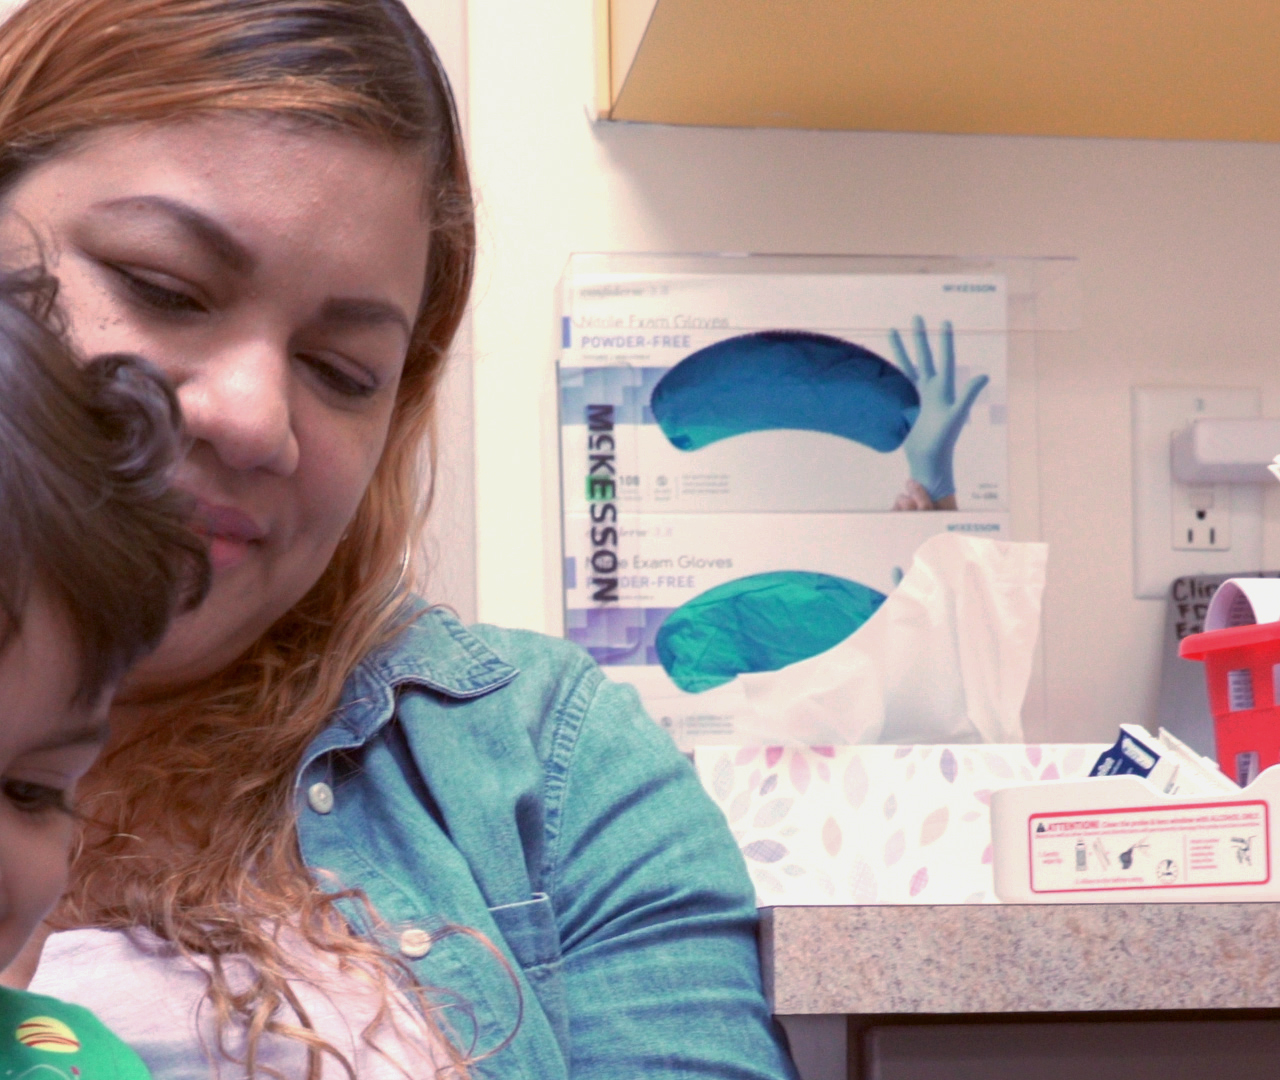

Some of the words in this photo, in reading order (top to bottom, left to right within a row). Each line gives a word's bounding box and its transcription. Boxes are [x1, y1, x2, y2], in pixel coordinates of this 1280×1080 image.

[628, 315, 670, 328] Exam
[673, 314, 729, 328] Gloves
[581, 335, 691, 348] POWDER-FREE
[633, 555, 674, 569] Exam
[677, 555, 733, 569] Gloves
[586, 575, 696, 588] PDER-FREE
